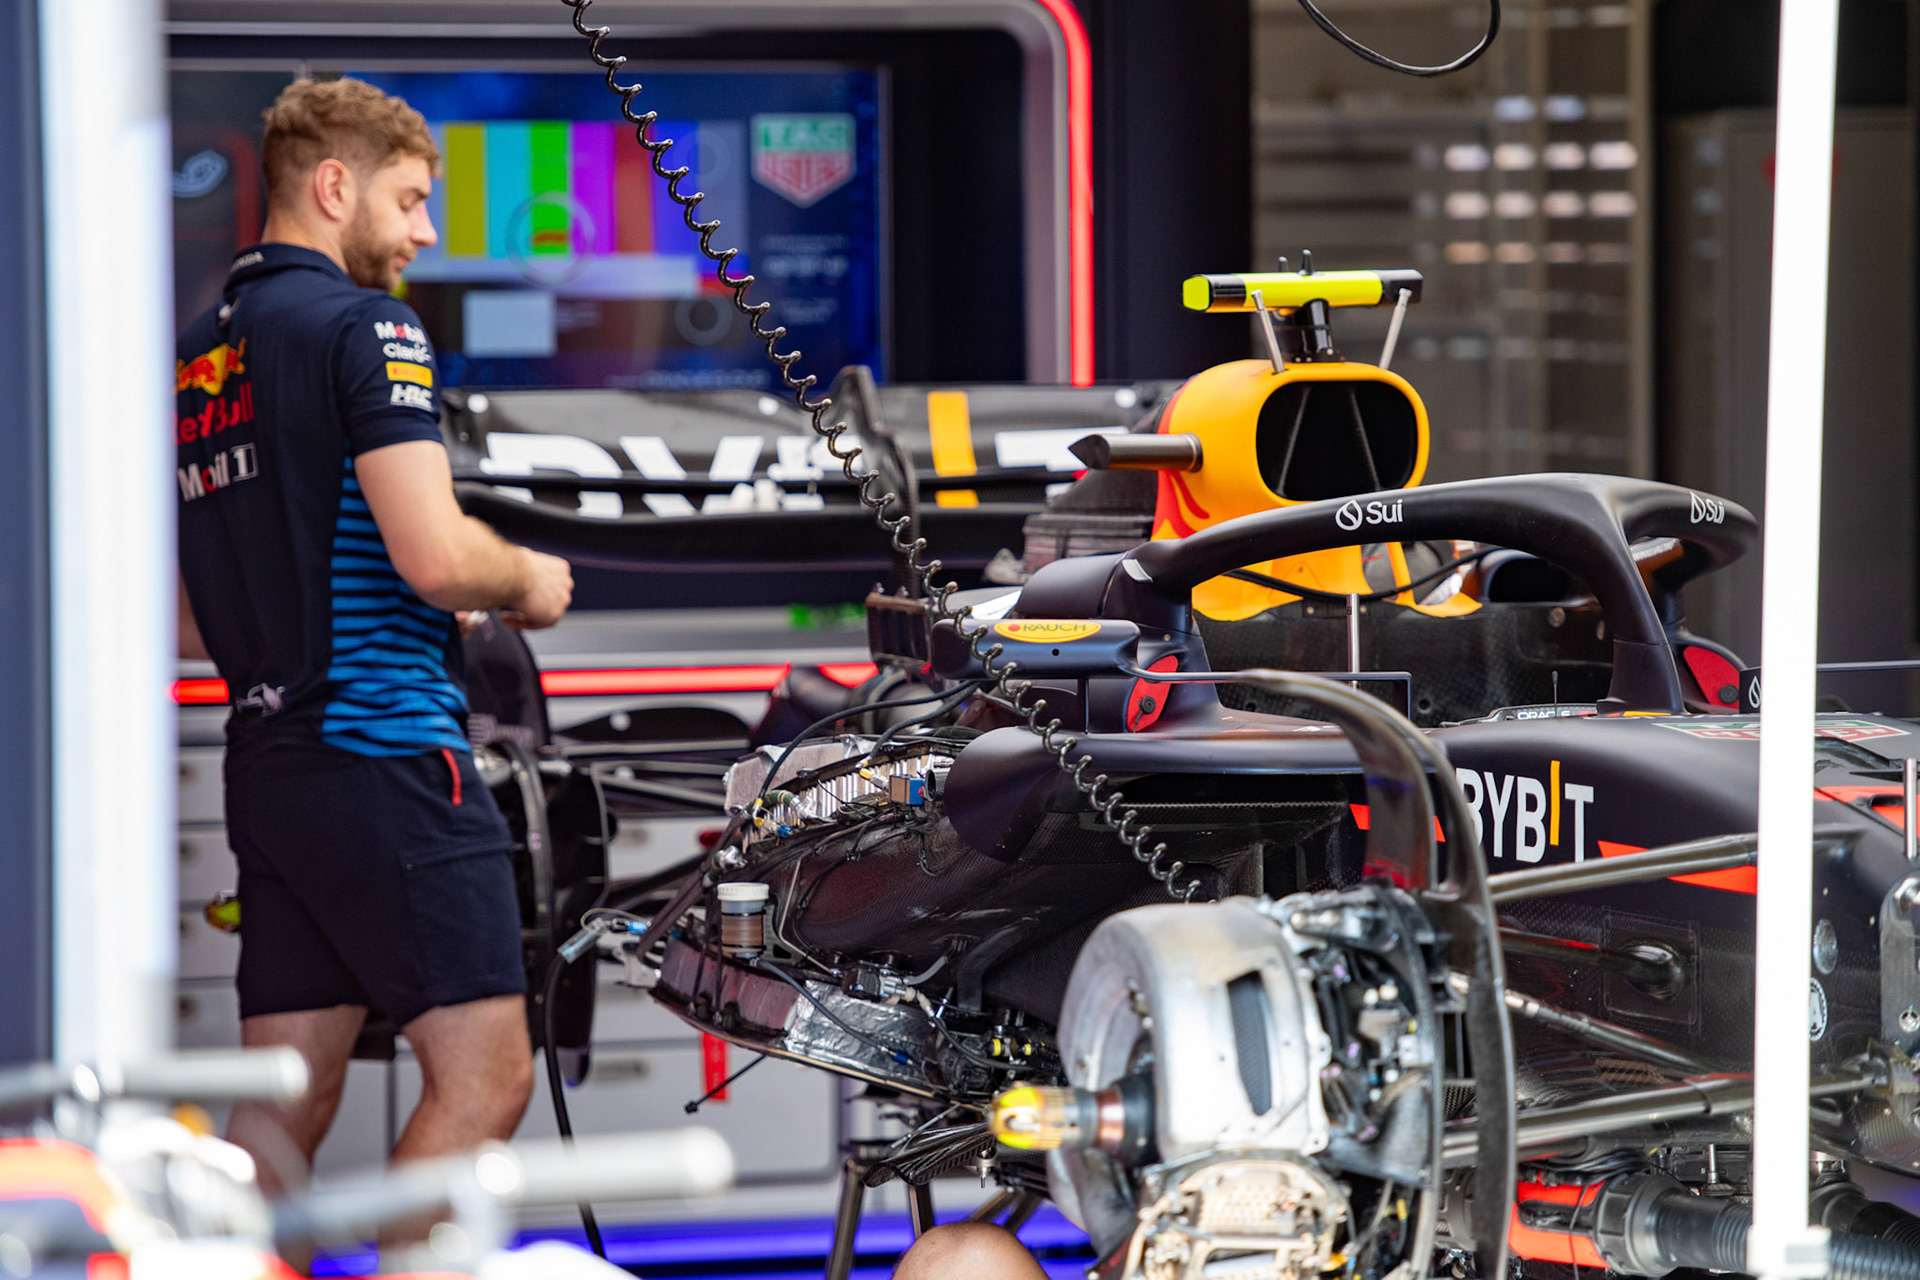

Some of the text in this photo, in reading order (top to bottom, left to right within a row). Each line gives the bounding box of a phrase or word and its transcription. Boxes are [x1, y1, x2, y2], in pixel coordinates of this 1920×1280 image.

[1365, 498, 1403, 525] Sui
[1705, 498, 1725, 525] Sui
[1023, 623, 1087, 632] RAUCH
[1517, 710, 1571, 720] ORACE
